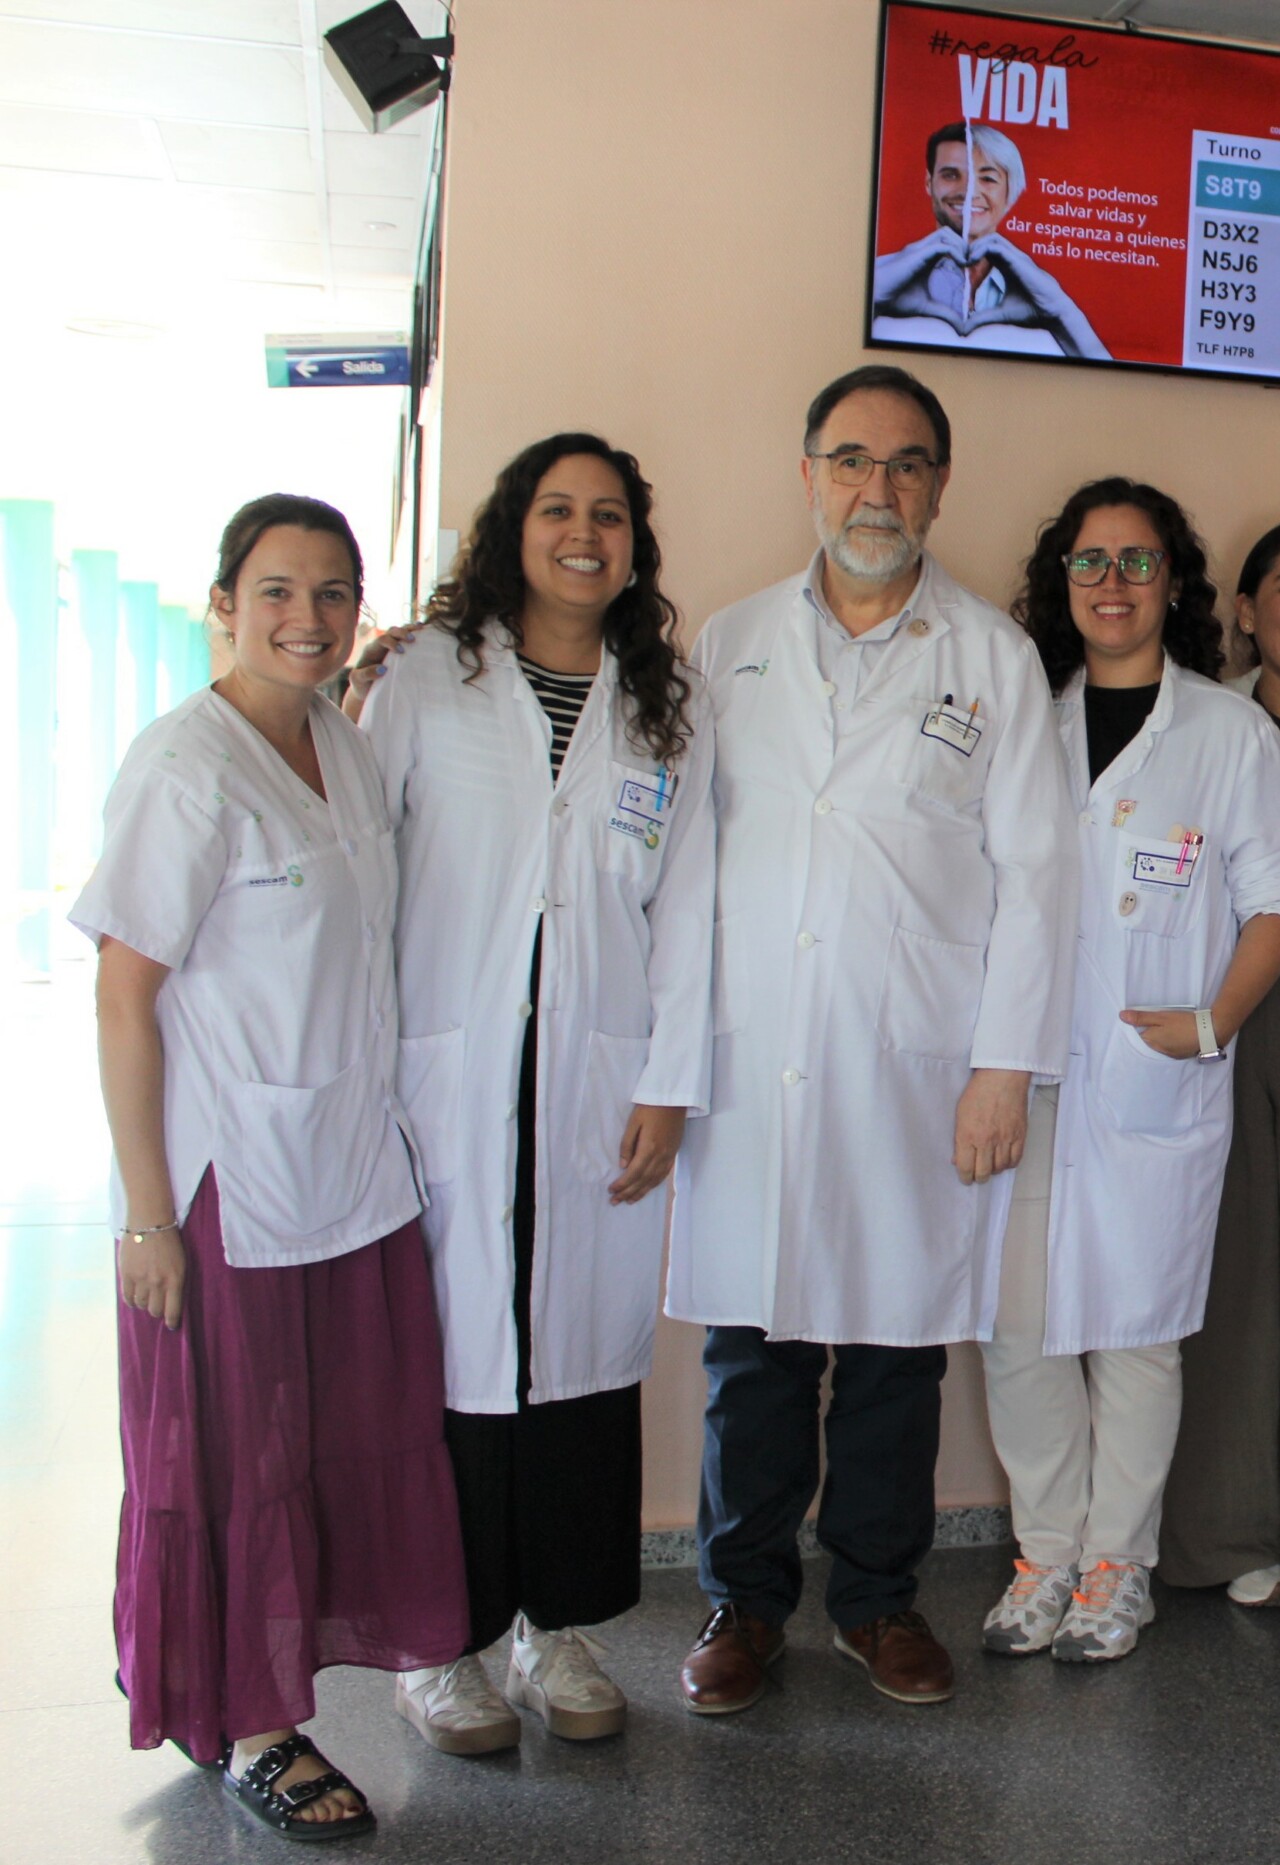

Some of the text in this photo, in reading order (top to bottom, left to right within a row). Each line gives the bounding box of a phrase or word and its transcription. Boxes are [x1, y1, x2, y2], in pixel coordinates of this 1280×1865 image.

[928, 29, 1099, 75] #regala
[958, 53, 1069, 129] VIDA
[1207, 139, 1261, 161] Turno
[1038, 178, 1158, 206] Todos podemos
[1205, 175, 1262, 200] S8T9
[1049, 202, 1147, 229] salvar vidas y
[1006, 216, 1186, 250] dar esperanza a quienes
[1203, 221, 1260, 244] D3X2
[1032, 240, 1160, 267] más lo necesitan.
[1202, 250, 1258, 274] N5J6
[1201, 280, 1257, 303] H3Y3
[1200, 309, 1256, 333] F9Y9
[1197, 343, 1255, 359] TLF H7P8
[342, 361, 385, 375] Salida
[249, 875, 288, 885] sescam
